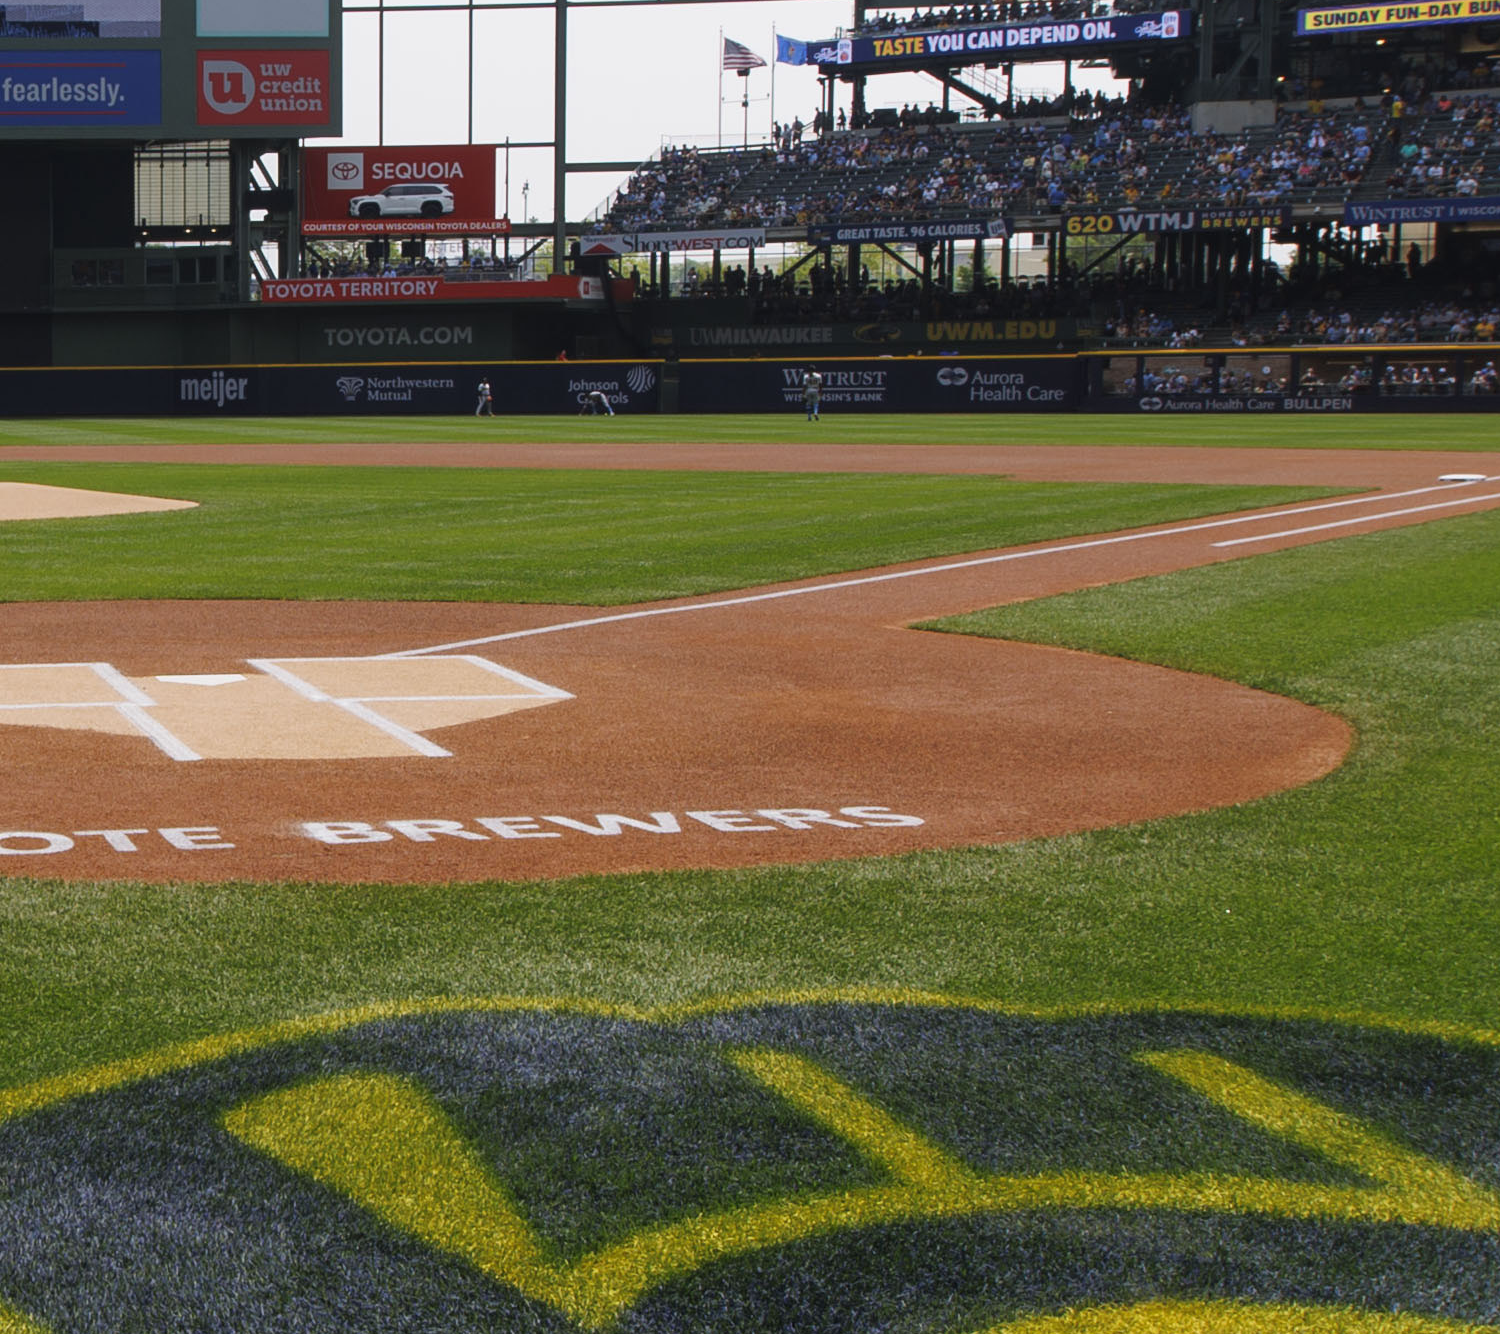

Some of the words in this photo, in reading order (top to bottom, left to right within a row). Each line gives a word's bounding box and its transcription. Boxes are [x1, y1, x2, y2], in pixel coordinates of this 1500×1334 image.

[872, 36, 924, 58] TASTE
[927, 34, 964, 54] YOU
[967, 30, 1004, 50] CAN
[1006, 24, 1079, 48] DEPEND
[1082, 21, 1116, 41] ON.
[260, 63, 292, 77] uw
[1, 76, 126, 108] fearlessly.
[260, 78, 322, 94] credit
[260, 94, 323, 112] union
[370, 161, 465, 182] SEQUOIA
[1351, 204, 1446, 221] WINTRUST
[303, 222, 347, 232] COURTESY
[361, 222, 385, 231] YOUR
[386, 221, 435, 231] WISCONSIN
[436, 221, 469, 231] TOYOTA
[470, 220, 508, 231] DEALERS
[1066, 214, 1114, 234] 620
[1117, 211, 1195, 233] WTMJ
[1201, 216, 1283, 229] BREWERS
[266, 282, 335, 300] TOYOTA
[339, 280, 439, 298] TERRITORY
[324, 326, 473, 348] TOYOTA.COM
[926, 320, 1057, 343] UWM.EDU
[366, 376, 455, 390] Northwestern
[971, 369, 1024, 385] Aurora
[180, 371, 248, 408] meijer
[567, 379, 620, 393] Johnson
[970, 385, 1024, 402] Health
[1027, 386, 1064, 402] Care
[366, 389, 413, 402] Mutual
[1283, 397, 1353, 411] BULLPEN
[294, 804, 927, 848] BREWERS
